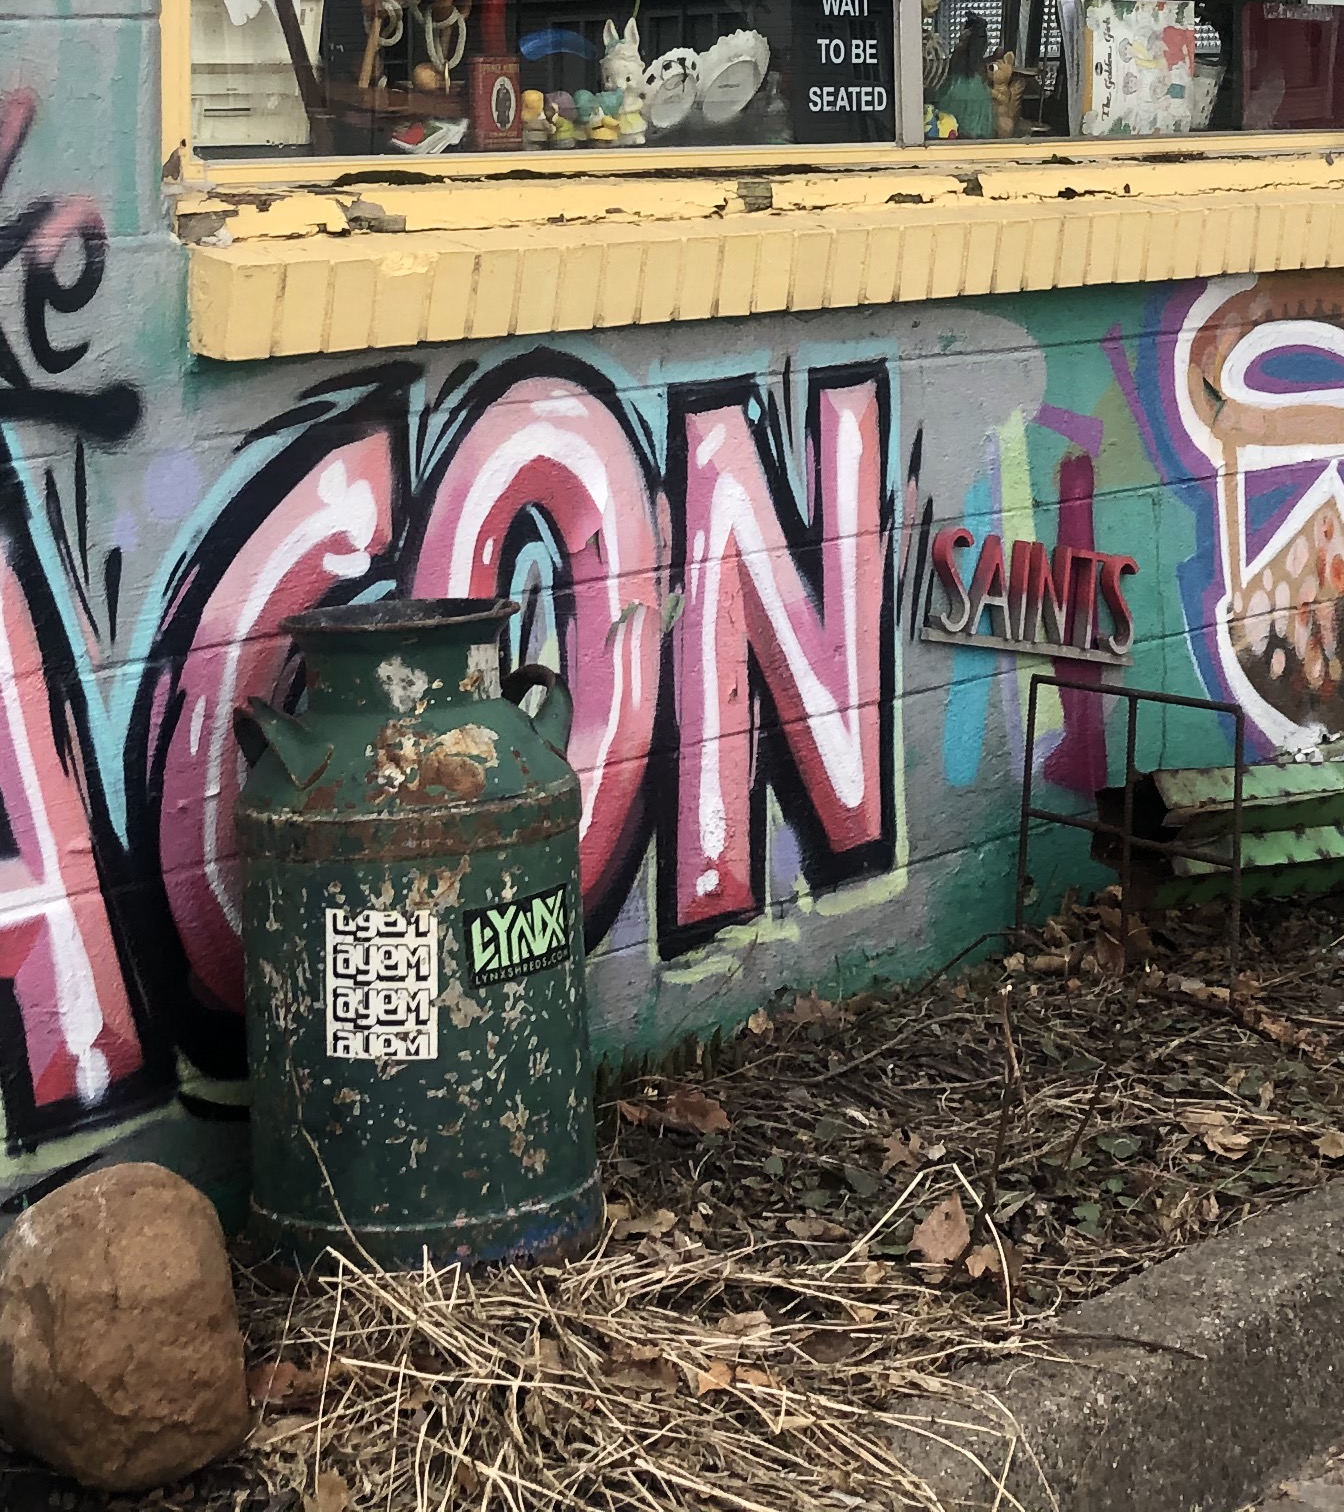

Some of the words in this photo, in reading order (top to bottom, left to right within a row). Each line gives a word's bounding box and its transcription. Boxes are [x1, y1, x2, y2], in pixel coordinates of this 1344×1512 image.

[817, 39, 845, 64] TO
[851, 40, 877, 64] BE
[808, 87, 887, 112] SEATED
[932, 528, 1139, 655] SAINTS
[471, 889, 566, 973] LYNX
